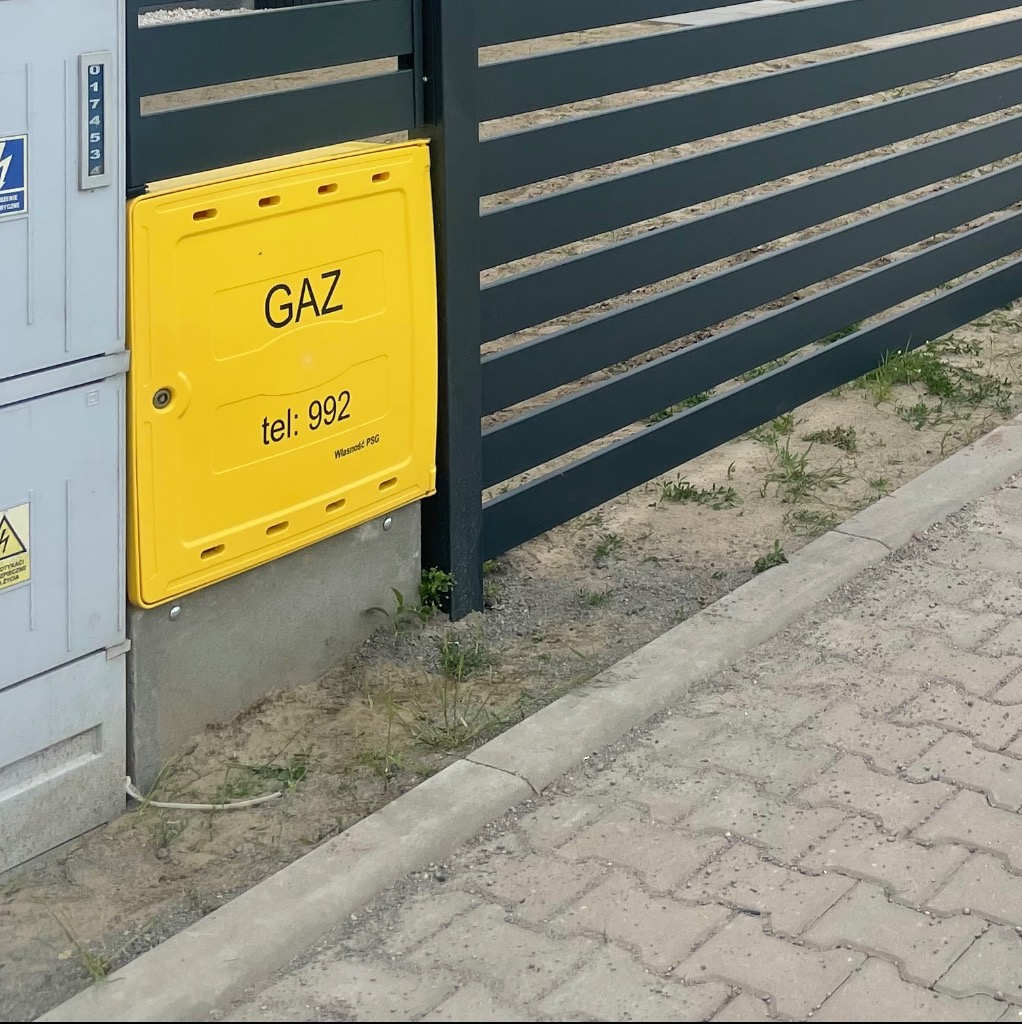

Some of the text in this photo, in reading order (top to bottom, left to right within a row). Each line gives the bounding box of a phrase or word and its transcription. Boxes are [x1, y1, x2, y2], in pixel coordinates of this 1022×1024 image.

[264, 269, 343, 329] GAZ
[261, 390, 350, 445] tel: 992
[366, 433, 380, 447] PSG
